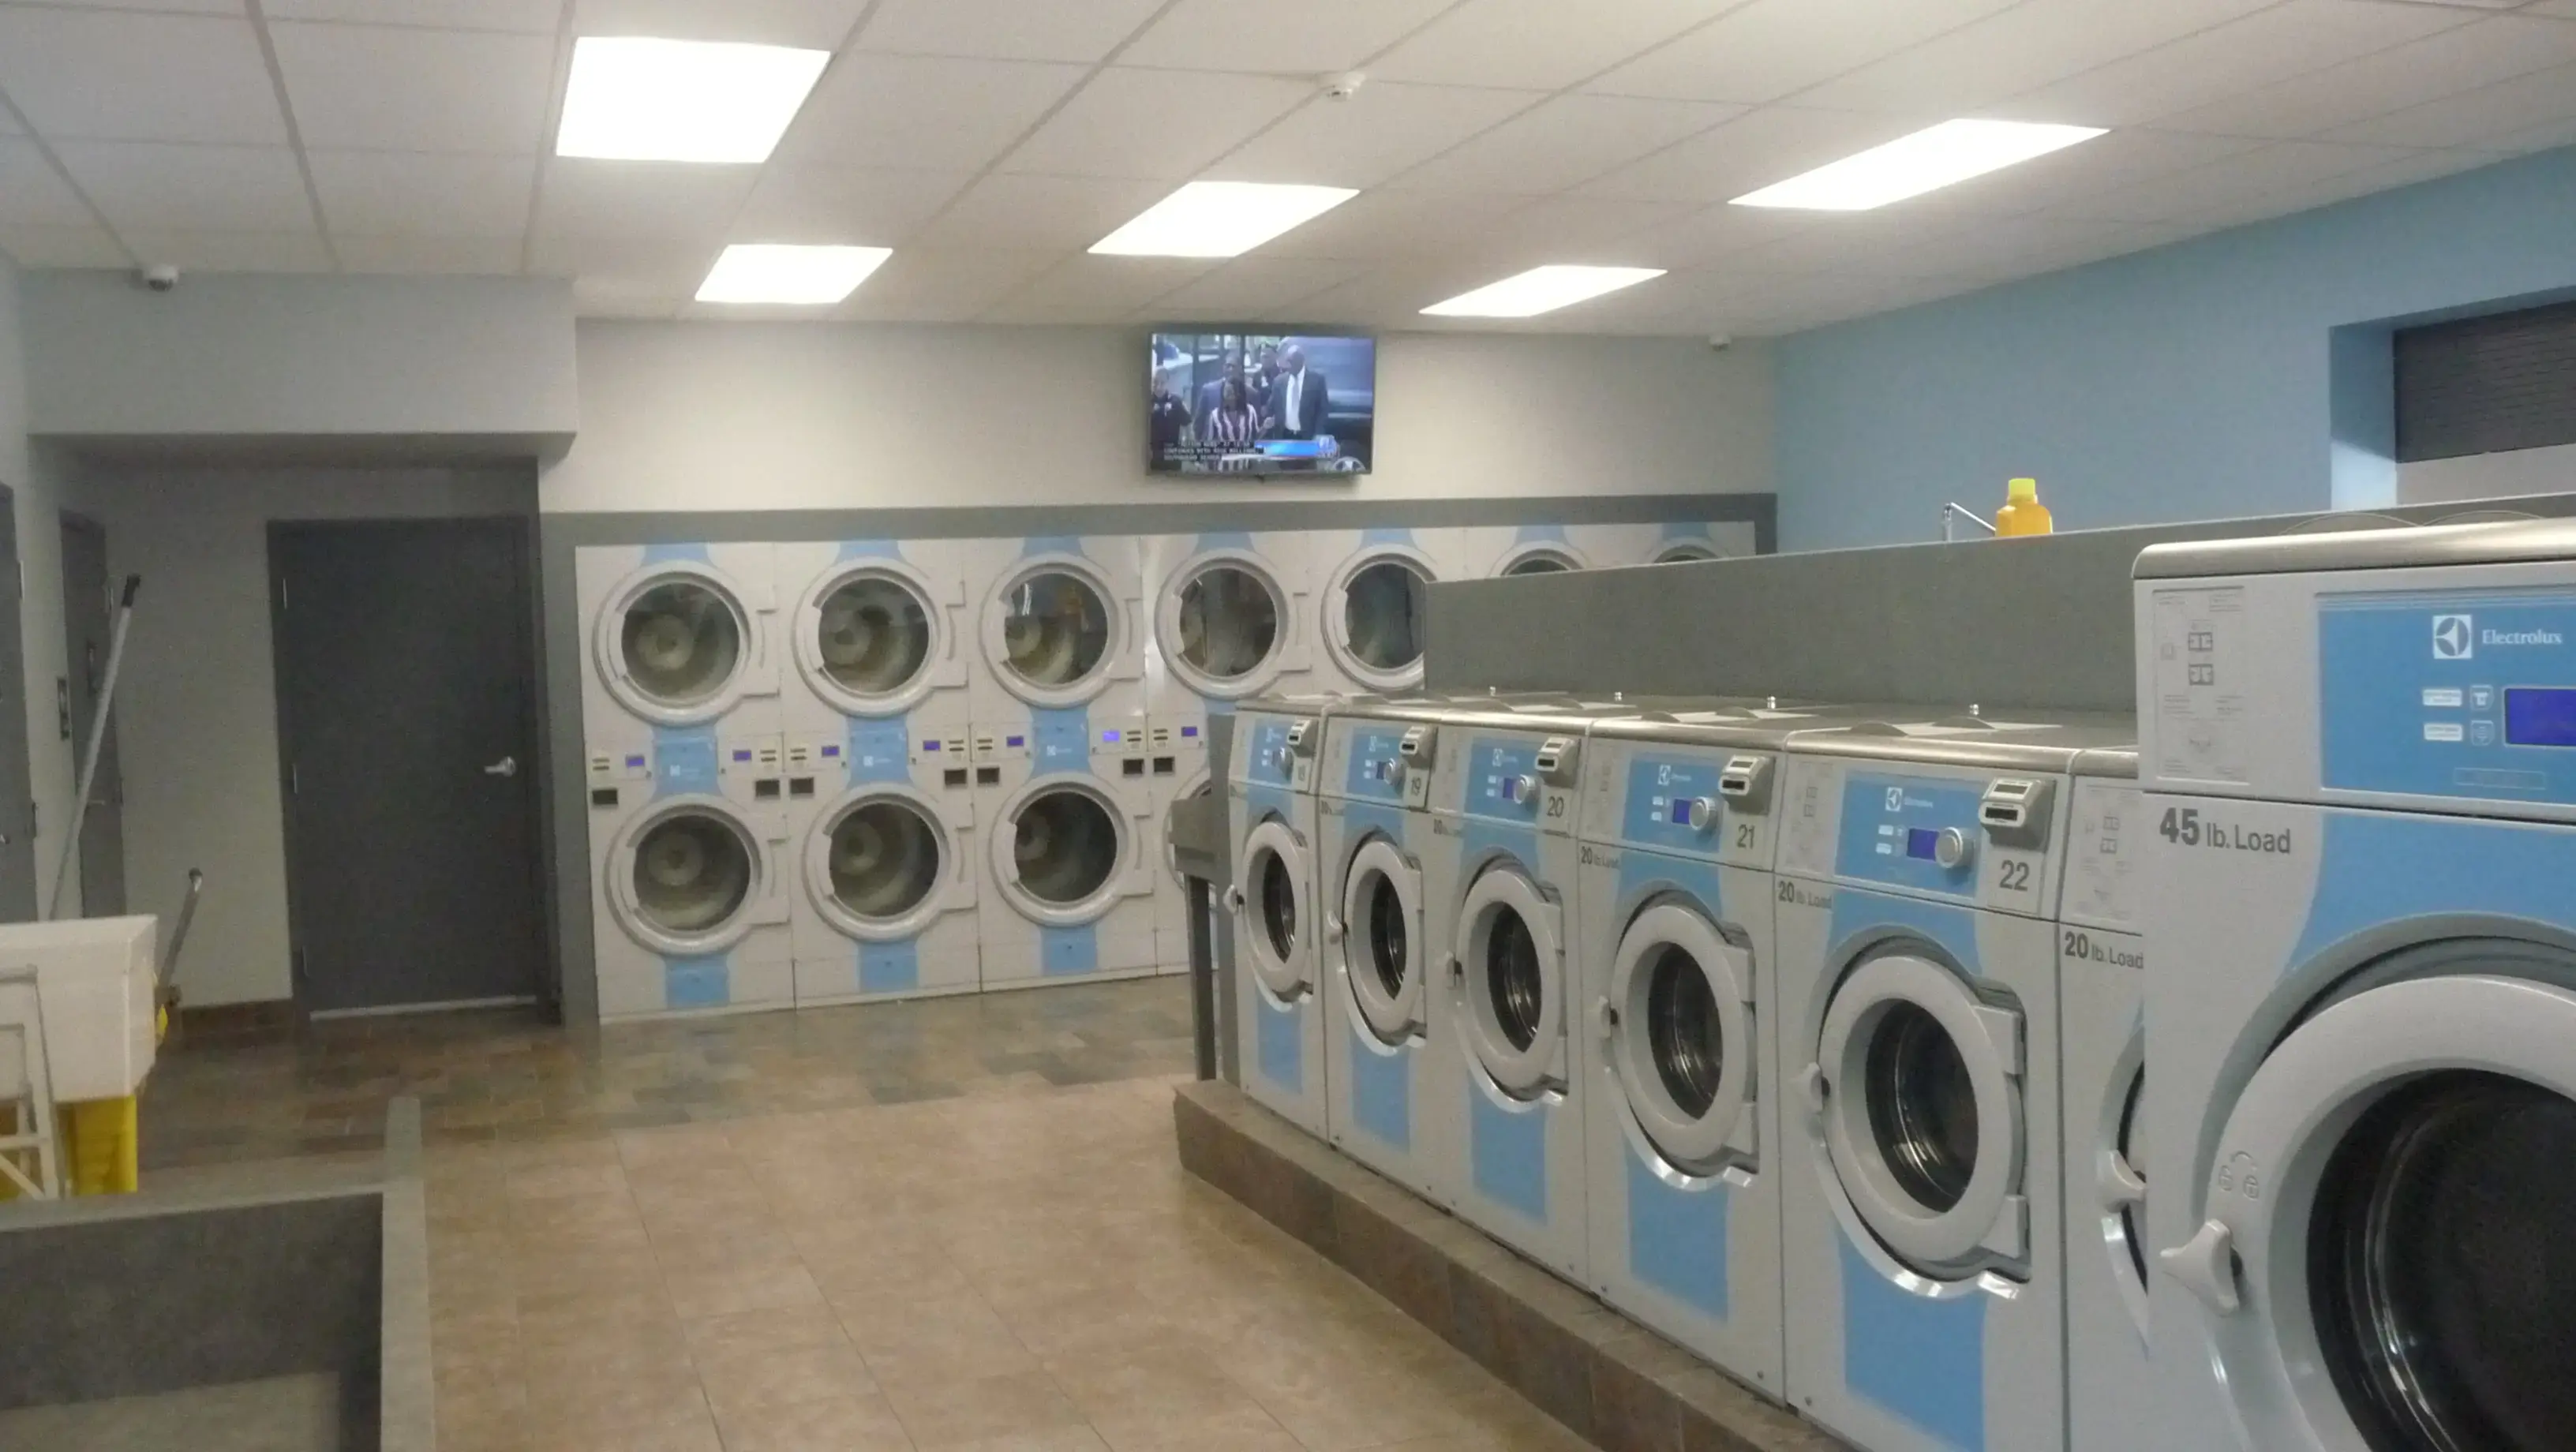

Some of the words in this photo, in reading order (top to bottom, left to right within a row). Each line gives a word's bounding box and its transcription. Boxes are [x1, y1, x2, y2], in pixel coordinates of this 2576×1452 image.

[2481, 629, 2564, 646] Electrolux
[1547, 795, 1564, 818] 20
[1737, 824, 1755, 850] 21
[2159, 806, 2200, 845] 45
[2206, 822, 2231, 848] lb.
[2235, 824, 2291, 854] Load
[1581, 845, 1593, 865] 20
[1999, 859, 2030, 892] 22
[1778, 881, 1795, 903] 20
[2065, 931, 2089, 959] 20
[2110, 946, 2144, 969] Load
